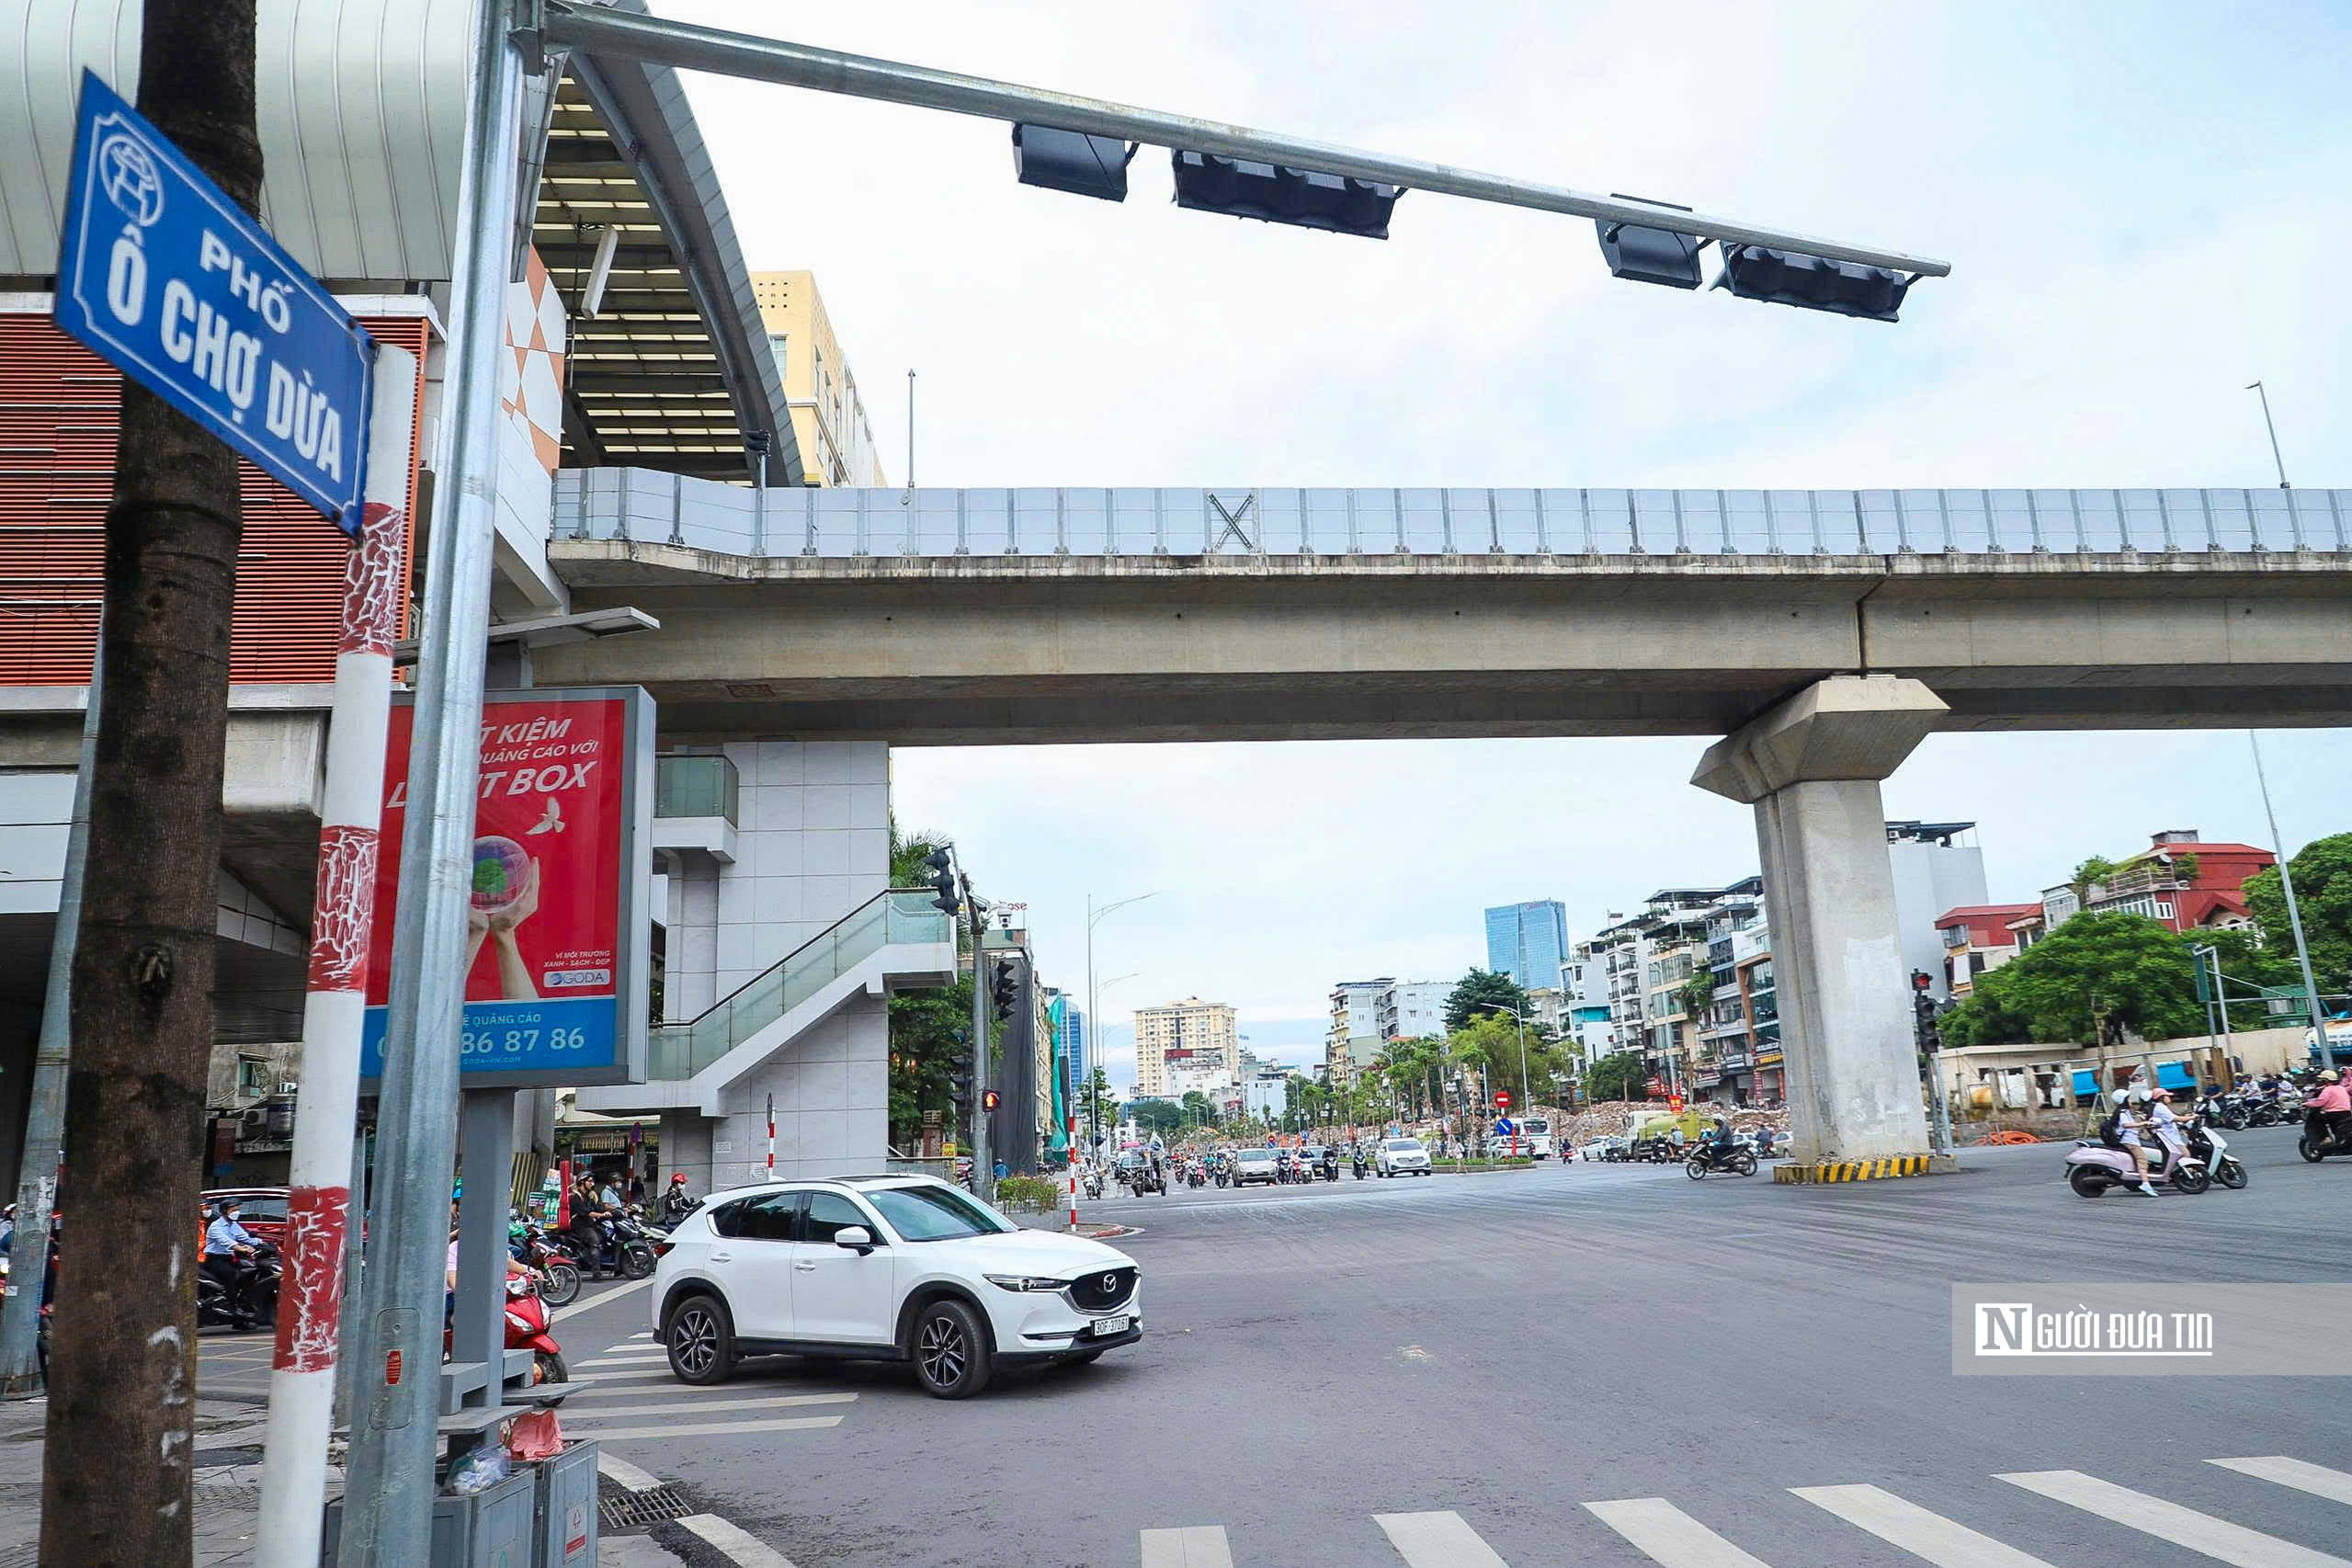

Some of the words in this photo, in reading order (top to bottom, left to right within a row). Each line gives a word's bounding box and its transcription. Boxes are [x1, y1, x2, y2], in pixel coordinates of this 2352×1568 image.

[199, 228, 296, 335] PHỐ
[107, 224, 147, 326] Ô
[160, 278, 263, 425] CHỢ
[266, 359, 342, 483] DỪA
[496, 716, 572, 746] KIỆM
[479, 747, 530, 764] UẢNG
[532, 743, 566, 759] CÁO
[506, 760, 598, 796] BOX
[472, 1012, 515, 1027] QUẢNG
[517, 1011, 542, 1024] CÁO
[504, 1029, 540, 1052] 87
[550, 1027, 585, 1051] 86
